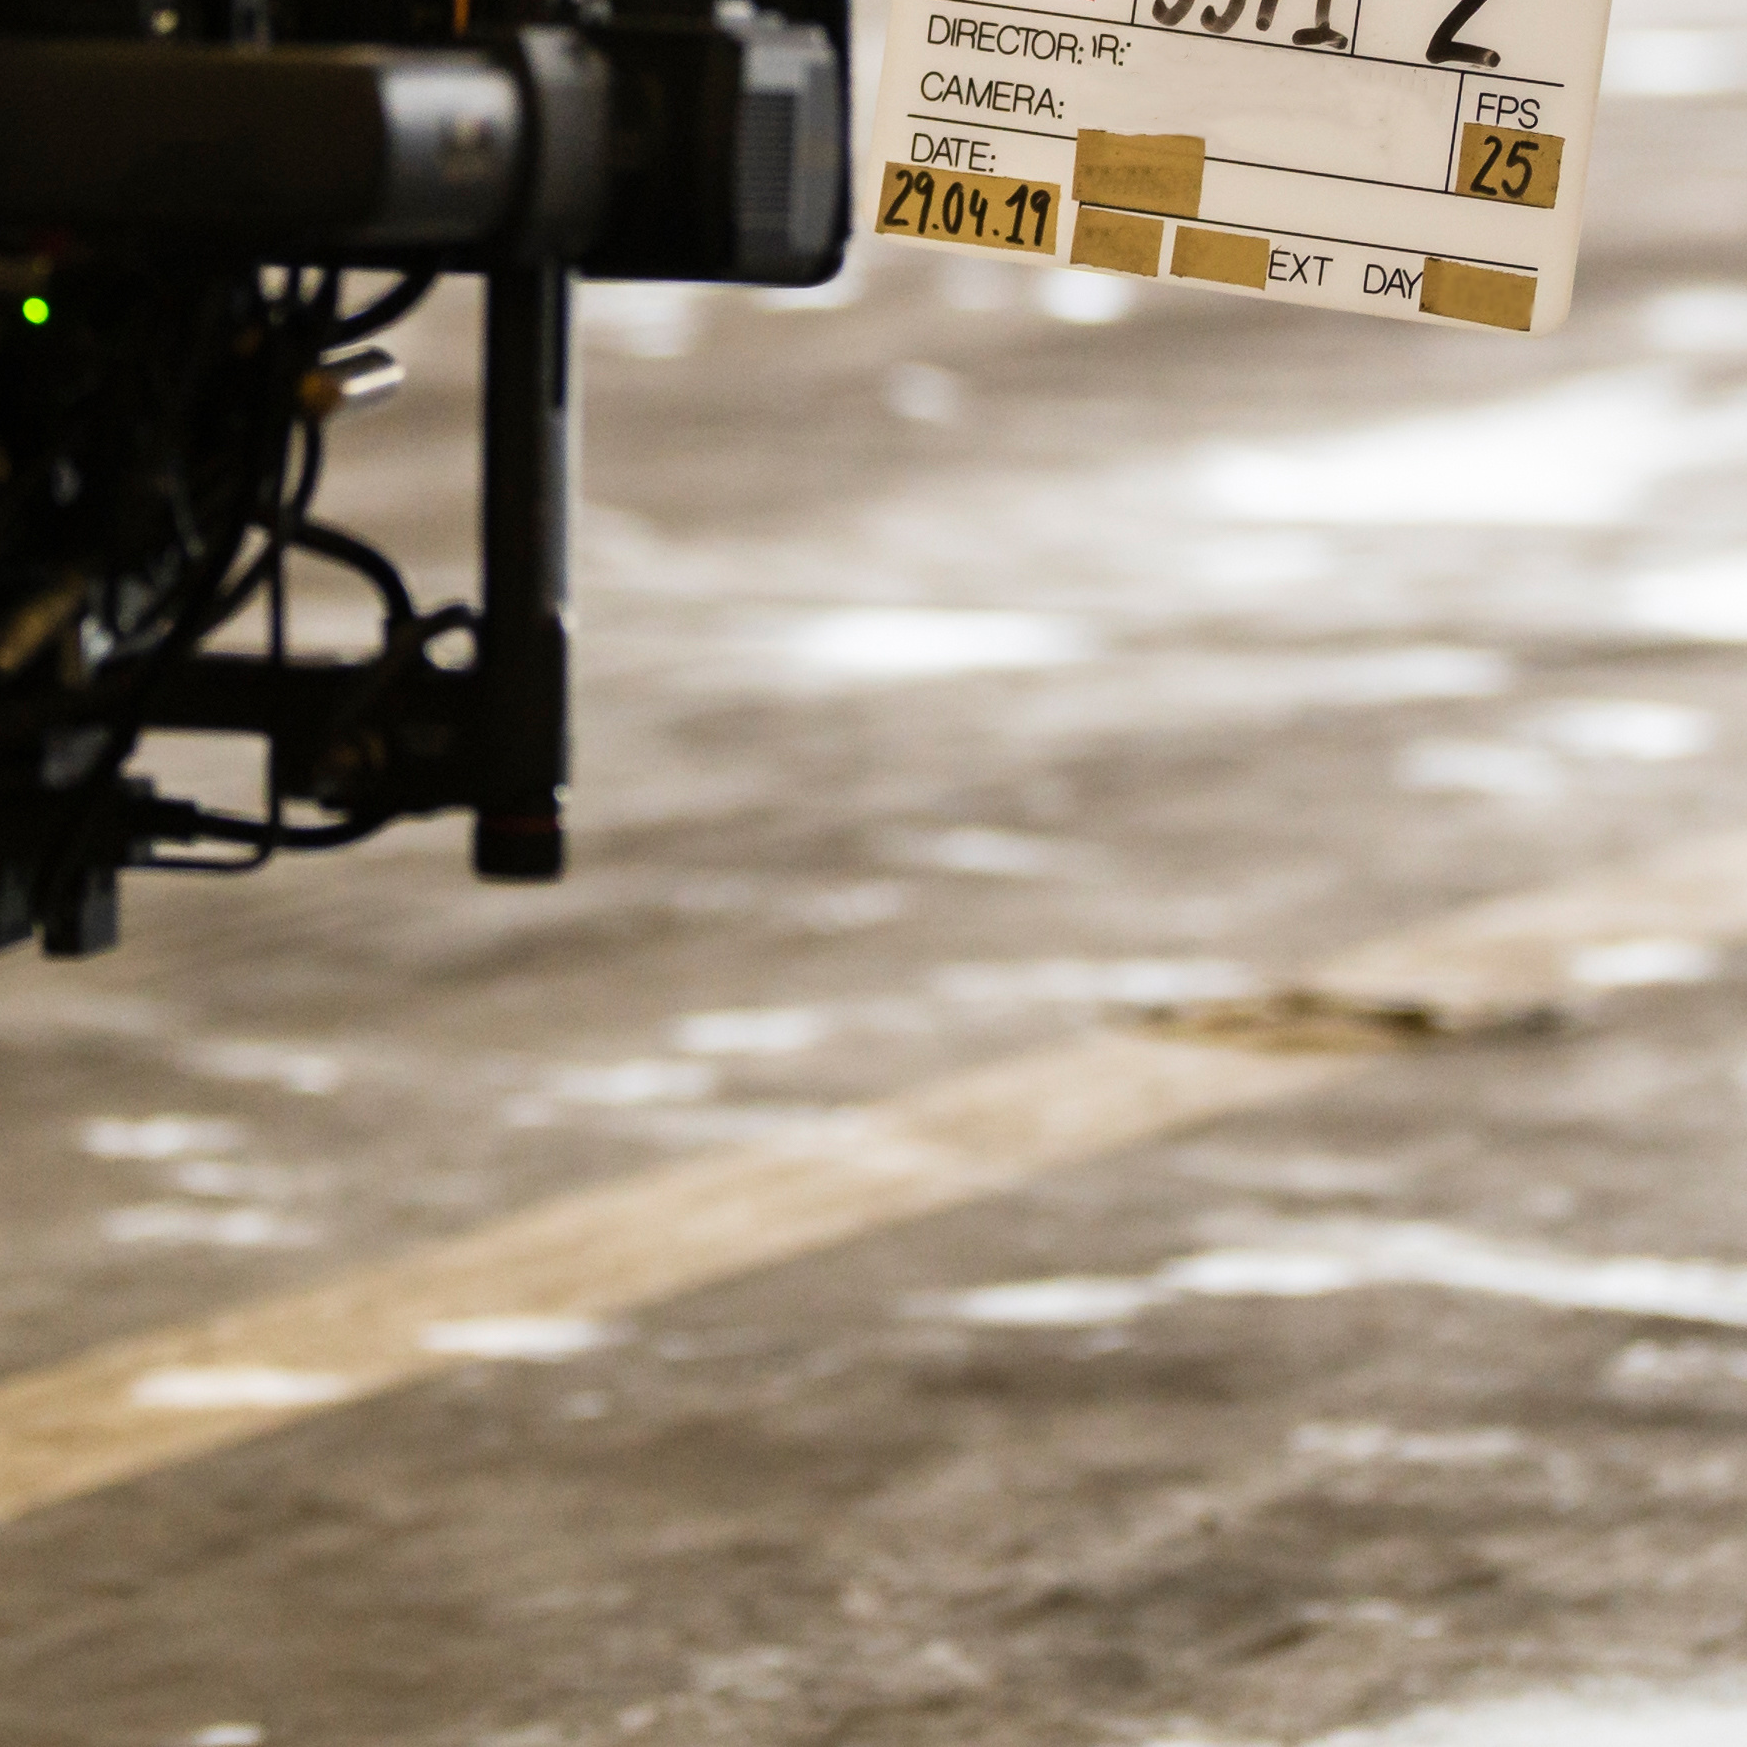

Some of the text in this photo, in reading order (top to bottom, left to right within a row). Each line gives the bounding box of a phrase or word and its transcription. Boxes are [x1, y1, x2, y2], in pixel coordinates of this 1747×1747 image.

[927, 14, 1084, 65] DIRECTOR:
[920, 71, 1065, 120] CAMERA:
[1476, 92, 1541, 129] FPS
[910, 133, 996, 173] DATE:
[1469, 135, 1540, 198] 25
[883, 169, 1052, 247] 29.04.19
[1267, 249, 1424, 300] EXT DAY
